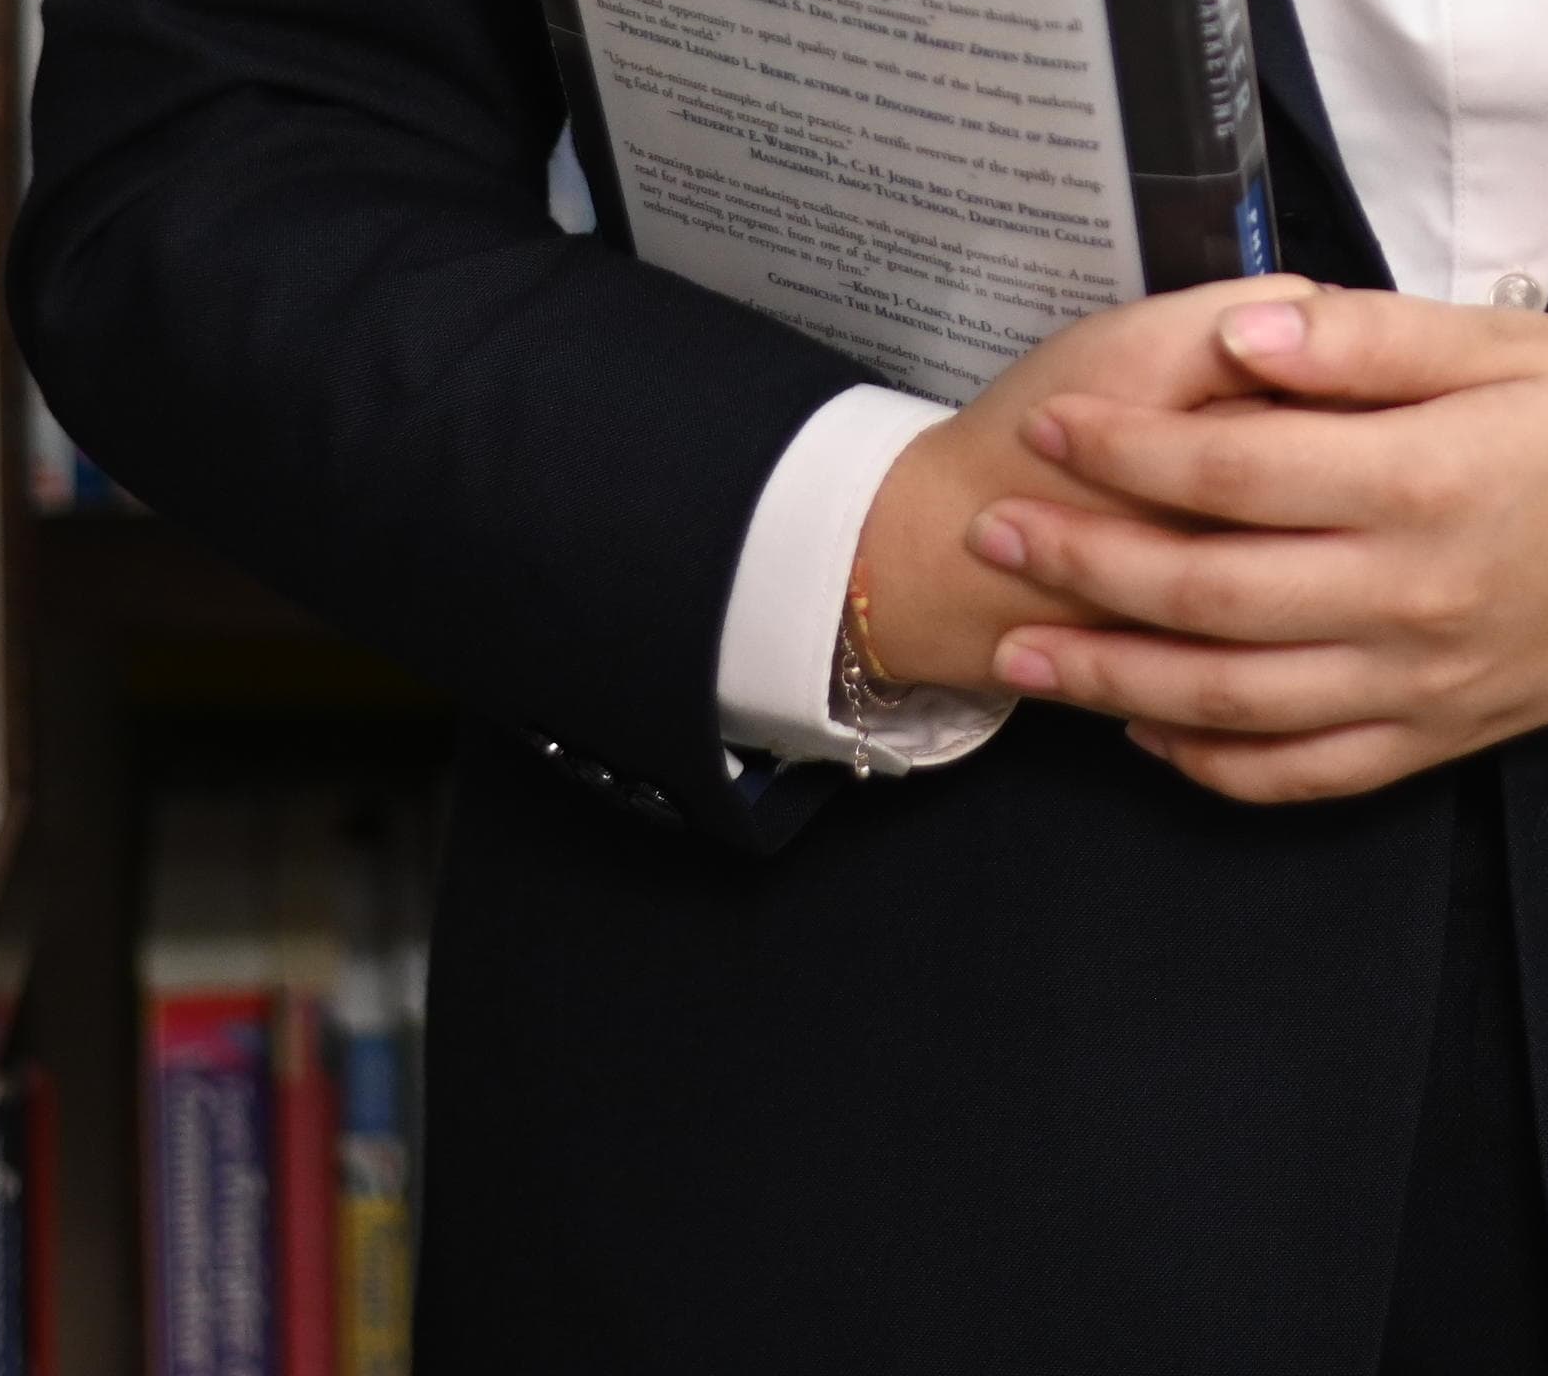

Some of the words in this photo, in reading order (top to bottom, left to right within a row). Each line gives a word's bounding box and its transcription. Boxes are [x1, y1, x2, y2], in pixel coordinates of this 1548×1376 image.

[630, 160, 659, 179] read
[680, 178, 722, 203] anyone
[723, 191, 783, 220] concerned
[784, 210, 812, 228] with
[985, 265, 1057, 295] monitoring
[638, 195, 690, 225] ordering
[690, 213, 728, 237] copies
[746, 233, 799, 260] everyone
[645, 149, 695, 178] amazing
[693, 165, 728, 188] guide
[741, 180, 801, 210] marketing
[863, 215, 892, 233] with
[892, 223, 938, 248] original
[964, 241, 1020, 268] powerful
[1023, 255, 1060, 275] advice.
